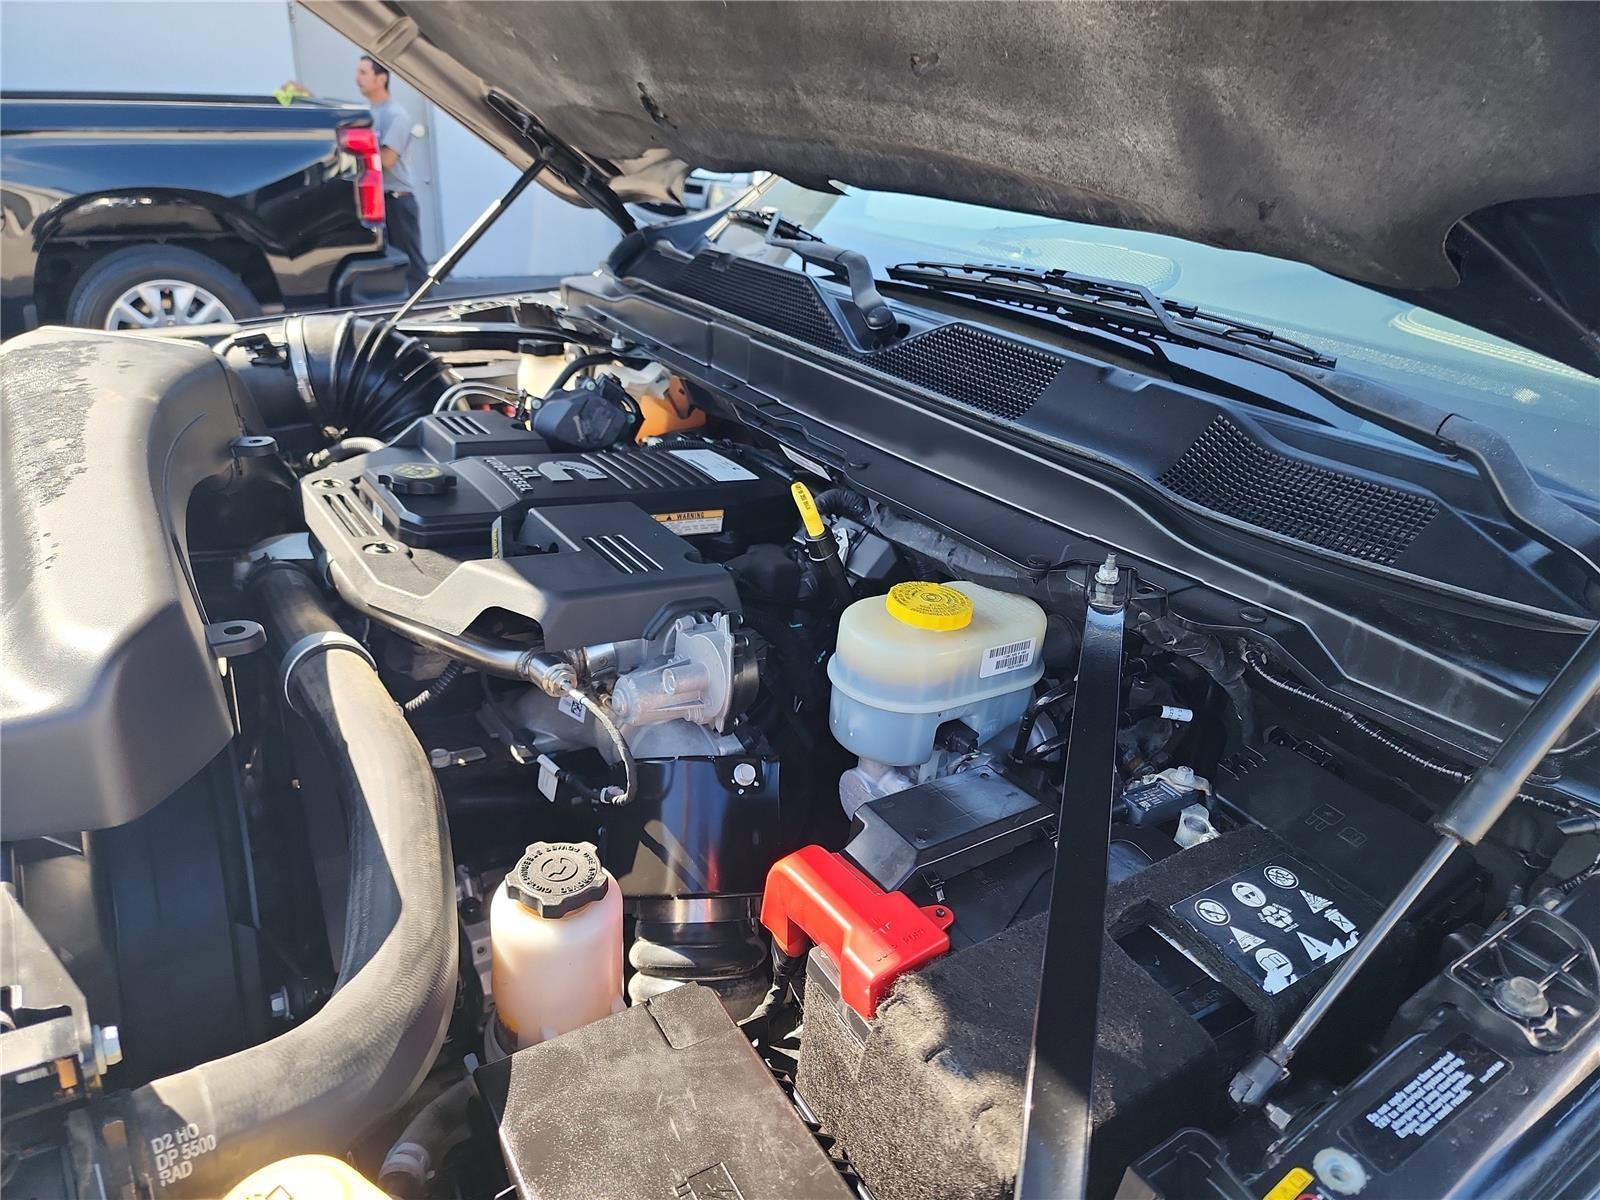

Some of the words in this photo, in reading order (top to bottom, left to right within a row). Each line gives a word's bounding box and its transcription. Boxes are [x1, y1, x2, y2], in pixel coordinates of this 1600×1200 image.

[502, 471, 533, 492] DIESEL
[676, 511, 705, 520] WARNING
[151, 1133, 174, 1154] D2
[175, 1122, 200, 1144] HO
[156, 1148, 179, 1171] DP
[181, 1134, 216, 1160] 5500
[159, 1160, 192, 1187] RAD
